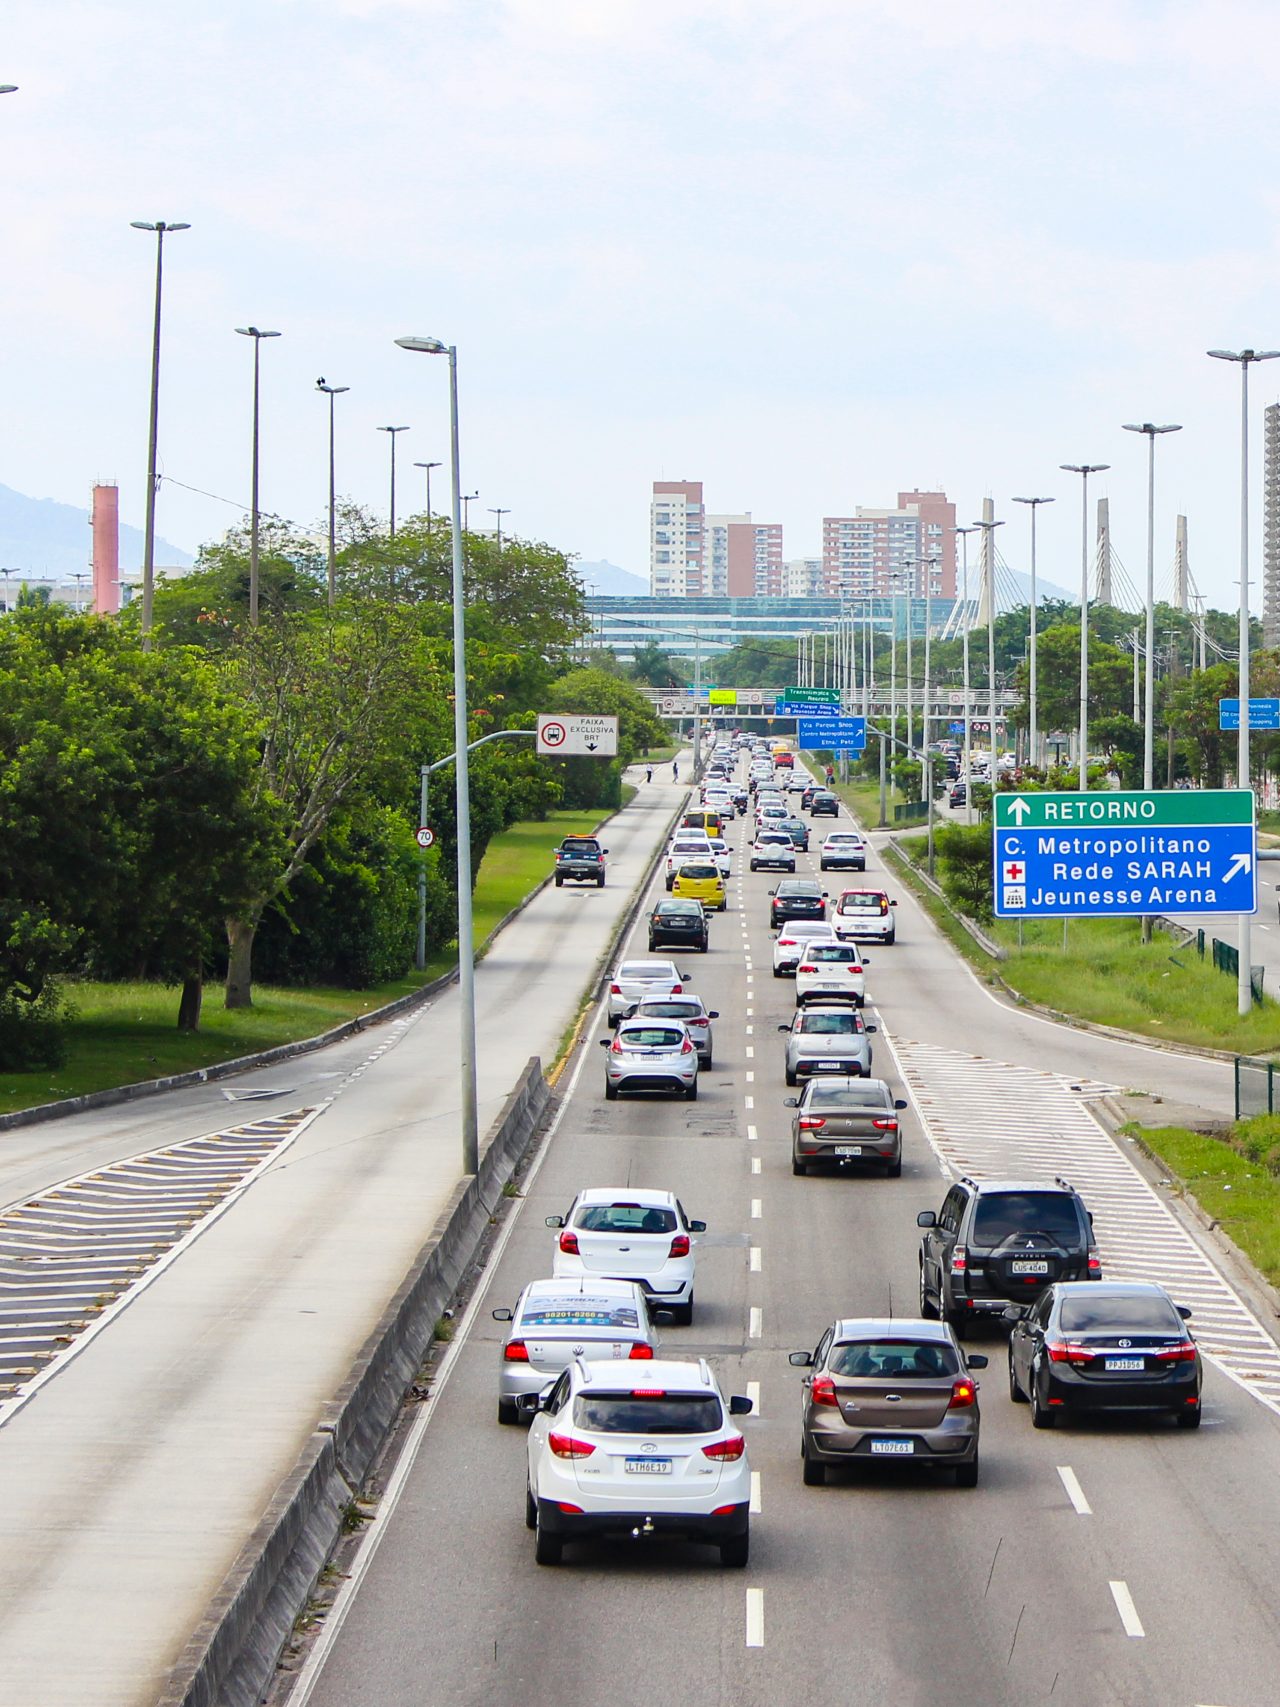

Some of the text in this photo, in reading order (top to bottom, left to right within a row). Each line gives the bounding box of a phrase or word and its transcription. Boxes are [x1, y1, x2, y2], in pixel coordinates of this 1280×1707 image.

[570, 726, 614, 734] EXCLUSIVA
[1044, 800, 1156, 820] RETORNO
[419, 831, 431, 841] 70
[1004, 836, 1211, 858] C. Metropolitano
[1053, 861, 1212, 880] Rede SARAH
[1031, 886, 1217, 906] Jeunesse Arena
